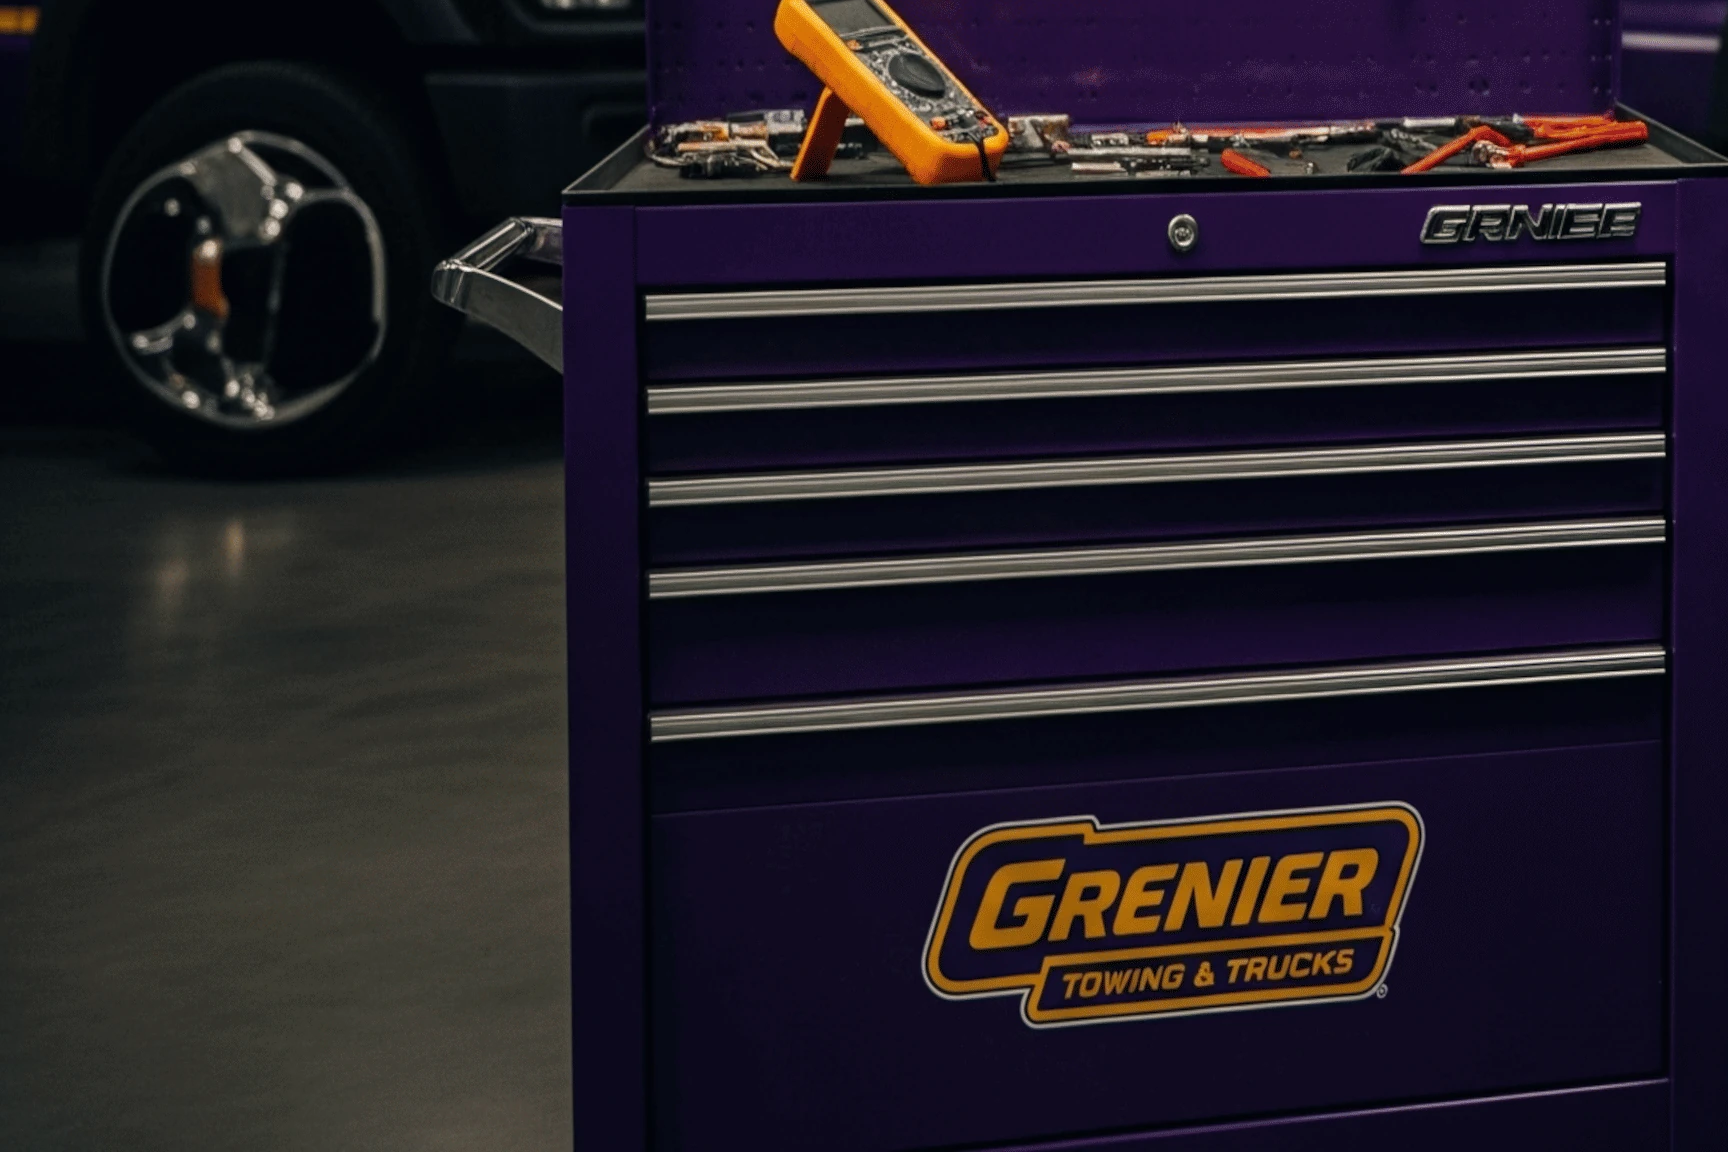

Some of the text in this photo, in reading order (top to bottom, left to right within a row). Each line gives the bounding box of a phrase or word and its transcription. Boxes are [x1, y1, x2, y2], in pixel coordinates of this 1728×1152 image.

[969, 848, 1379, 950] GRENIER
[1062, 949, 1355, 1000] TOWING & TRUCKS
